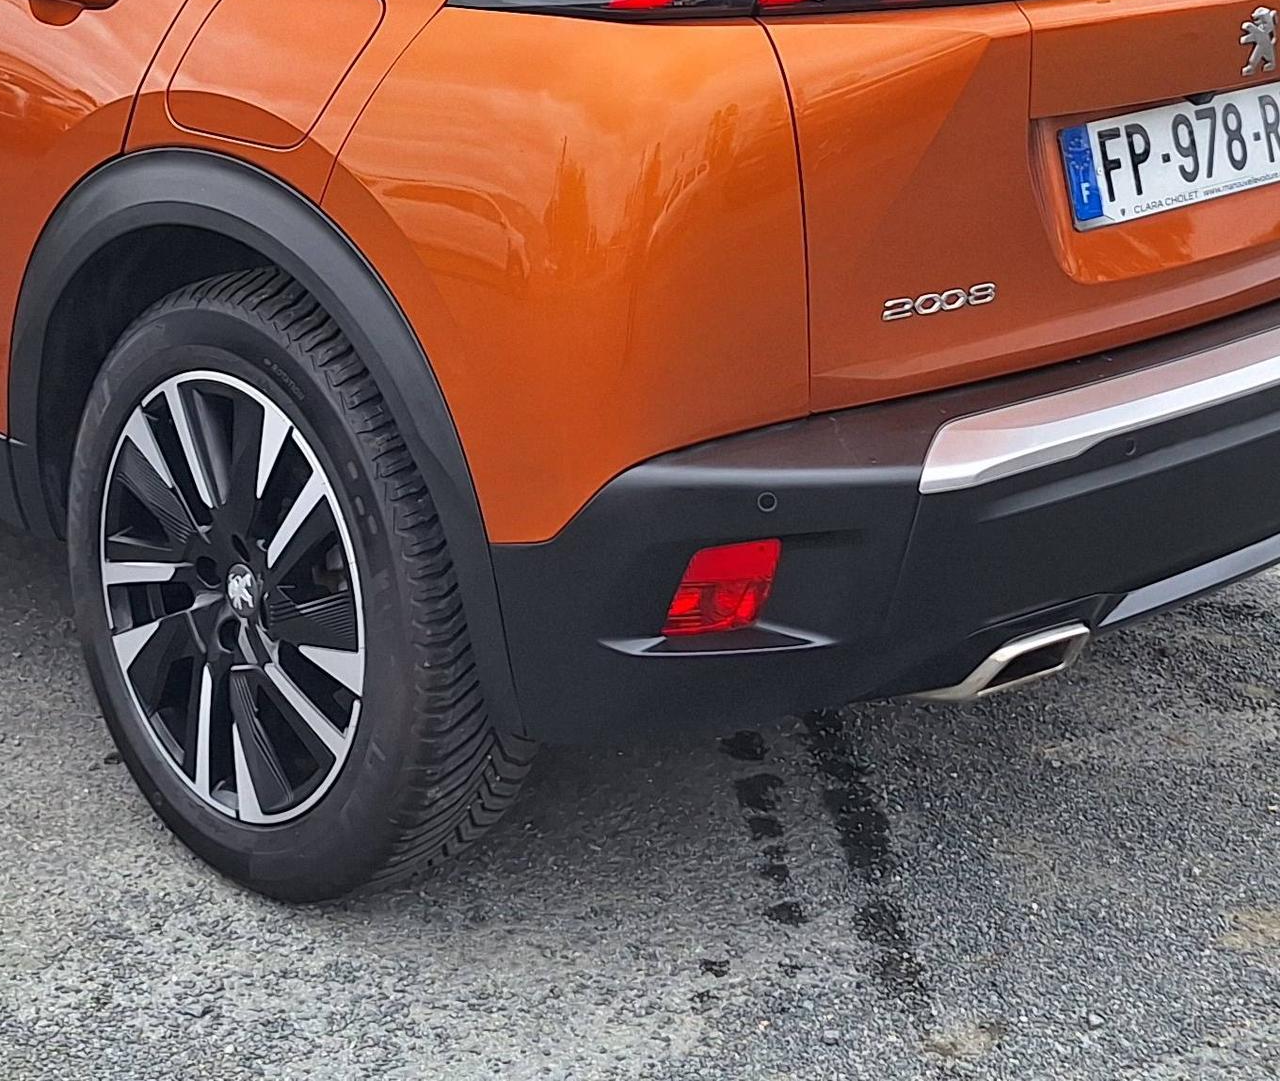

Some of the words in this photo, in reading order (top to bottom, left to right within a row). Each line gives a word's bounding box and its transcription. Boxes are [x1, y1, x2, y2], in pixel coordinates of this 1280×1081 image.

[1081, 182, 1091, 204] F
[1133, 199, 1164, 215] CLARA
[1165, 190, 1199, 207] CHOLET
[882, 282, 997, 321] 2008
